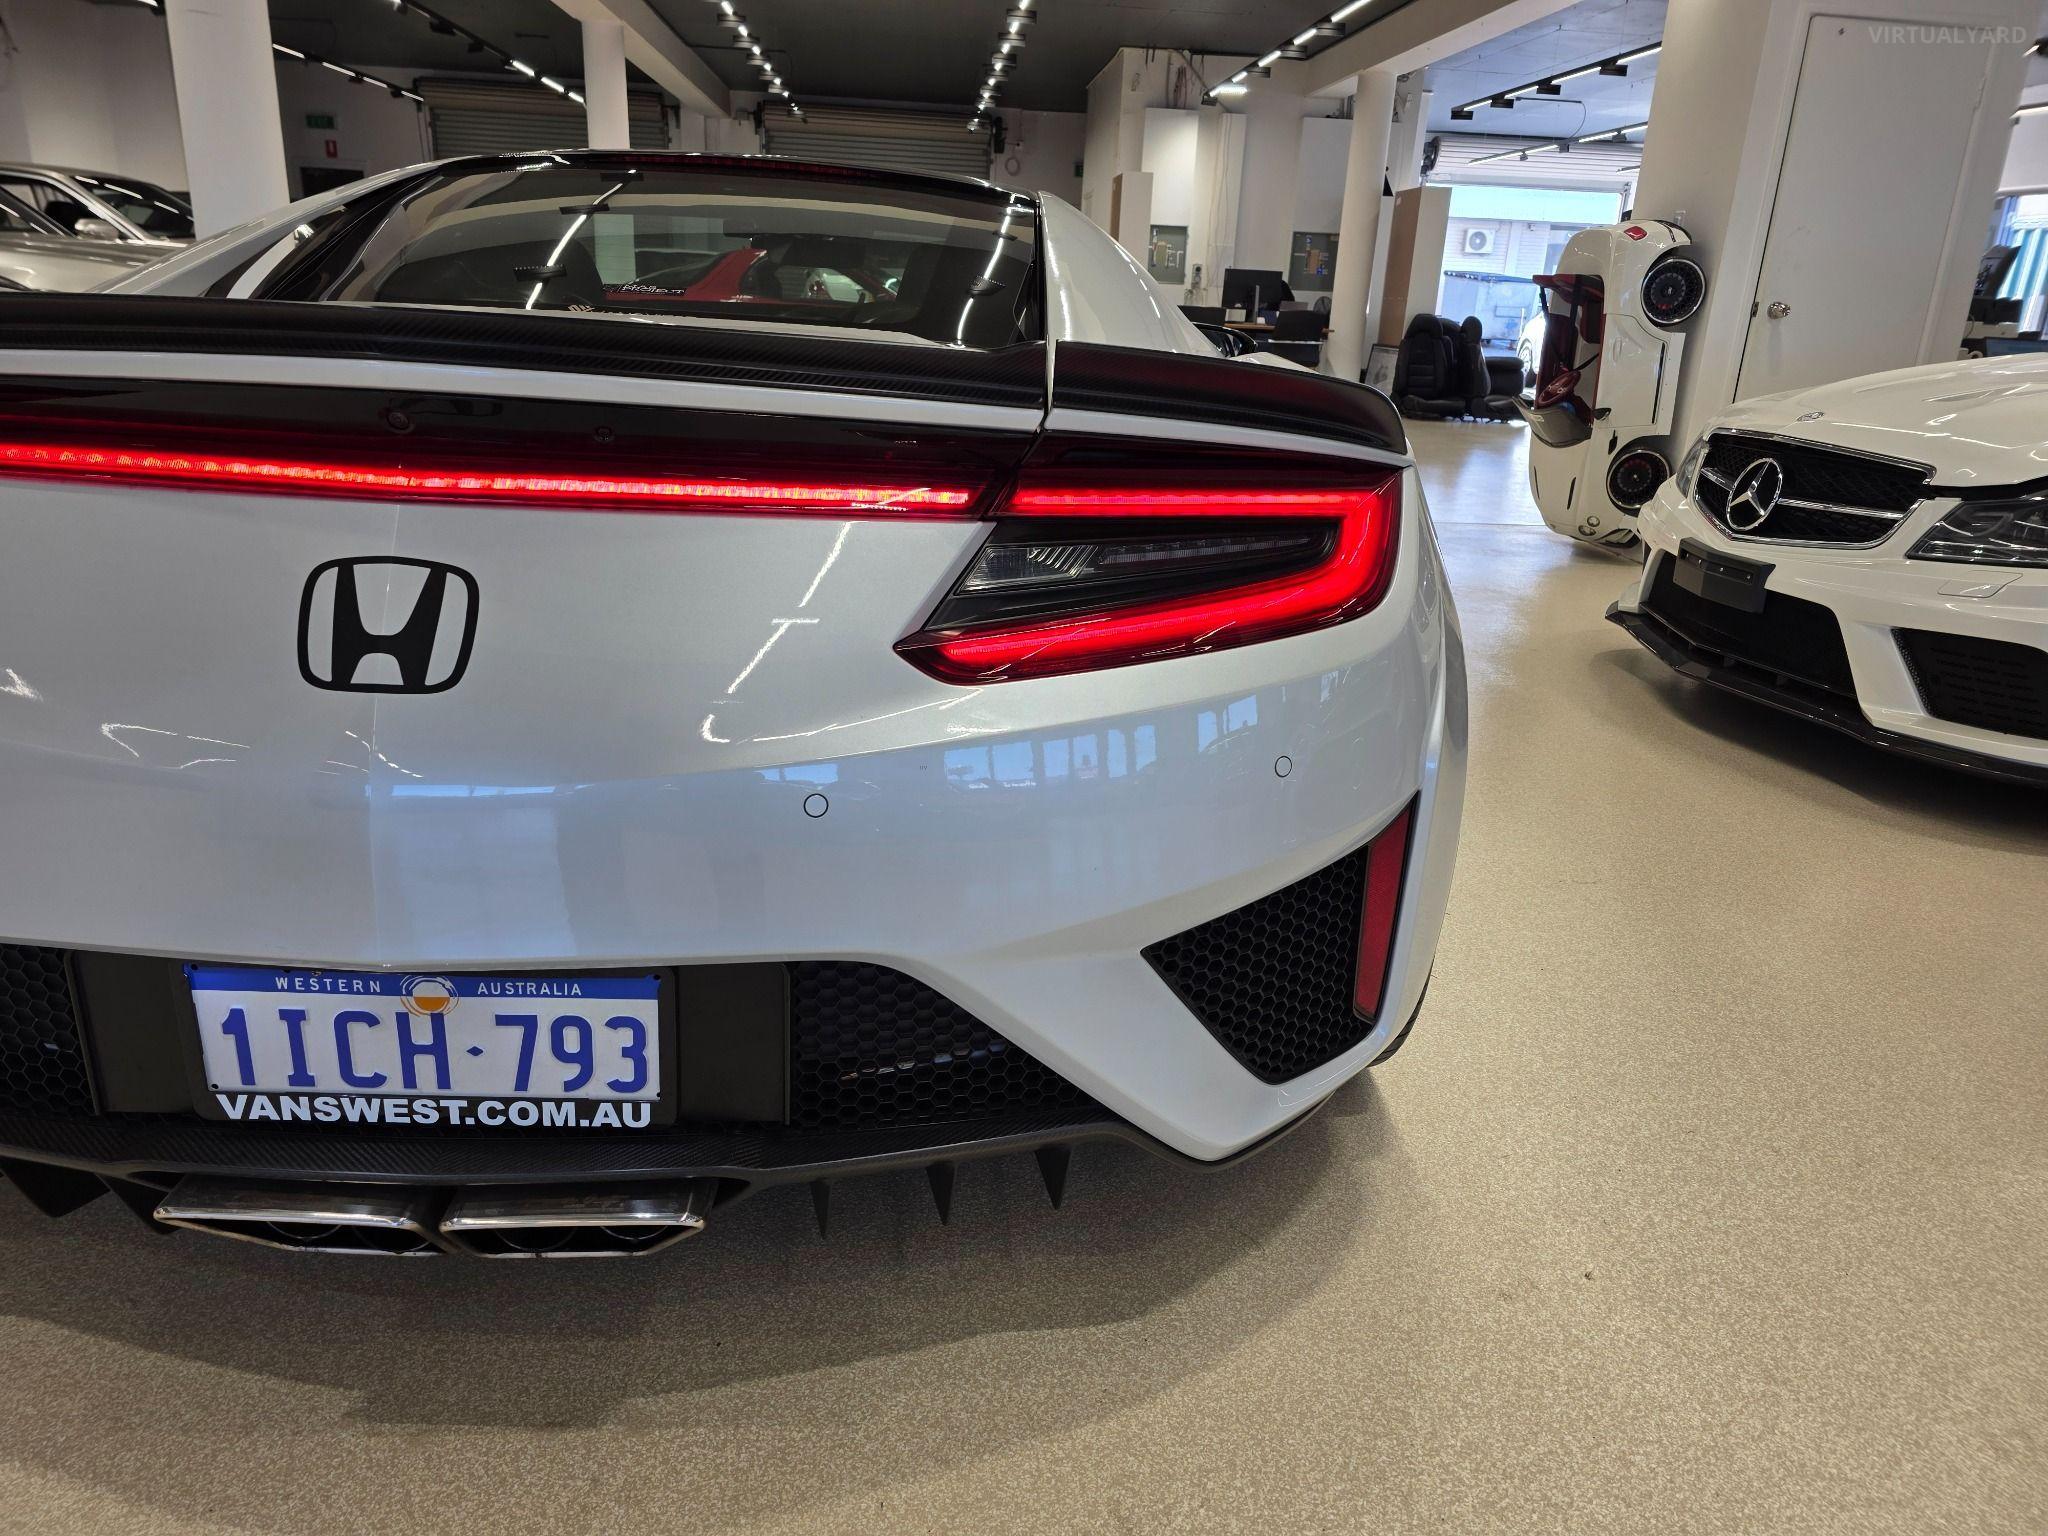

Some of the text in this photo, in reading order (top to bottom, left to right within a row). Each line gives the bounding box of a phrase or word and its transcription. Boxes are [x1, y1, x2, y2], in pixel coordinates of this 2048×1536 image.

[275, 977, 582, 997] WESTERN AUSTRALIA
[216, 1094, 651, 1128] VANSWEST.COM.AU
